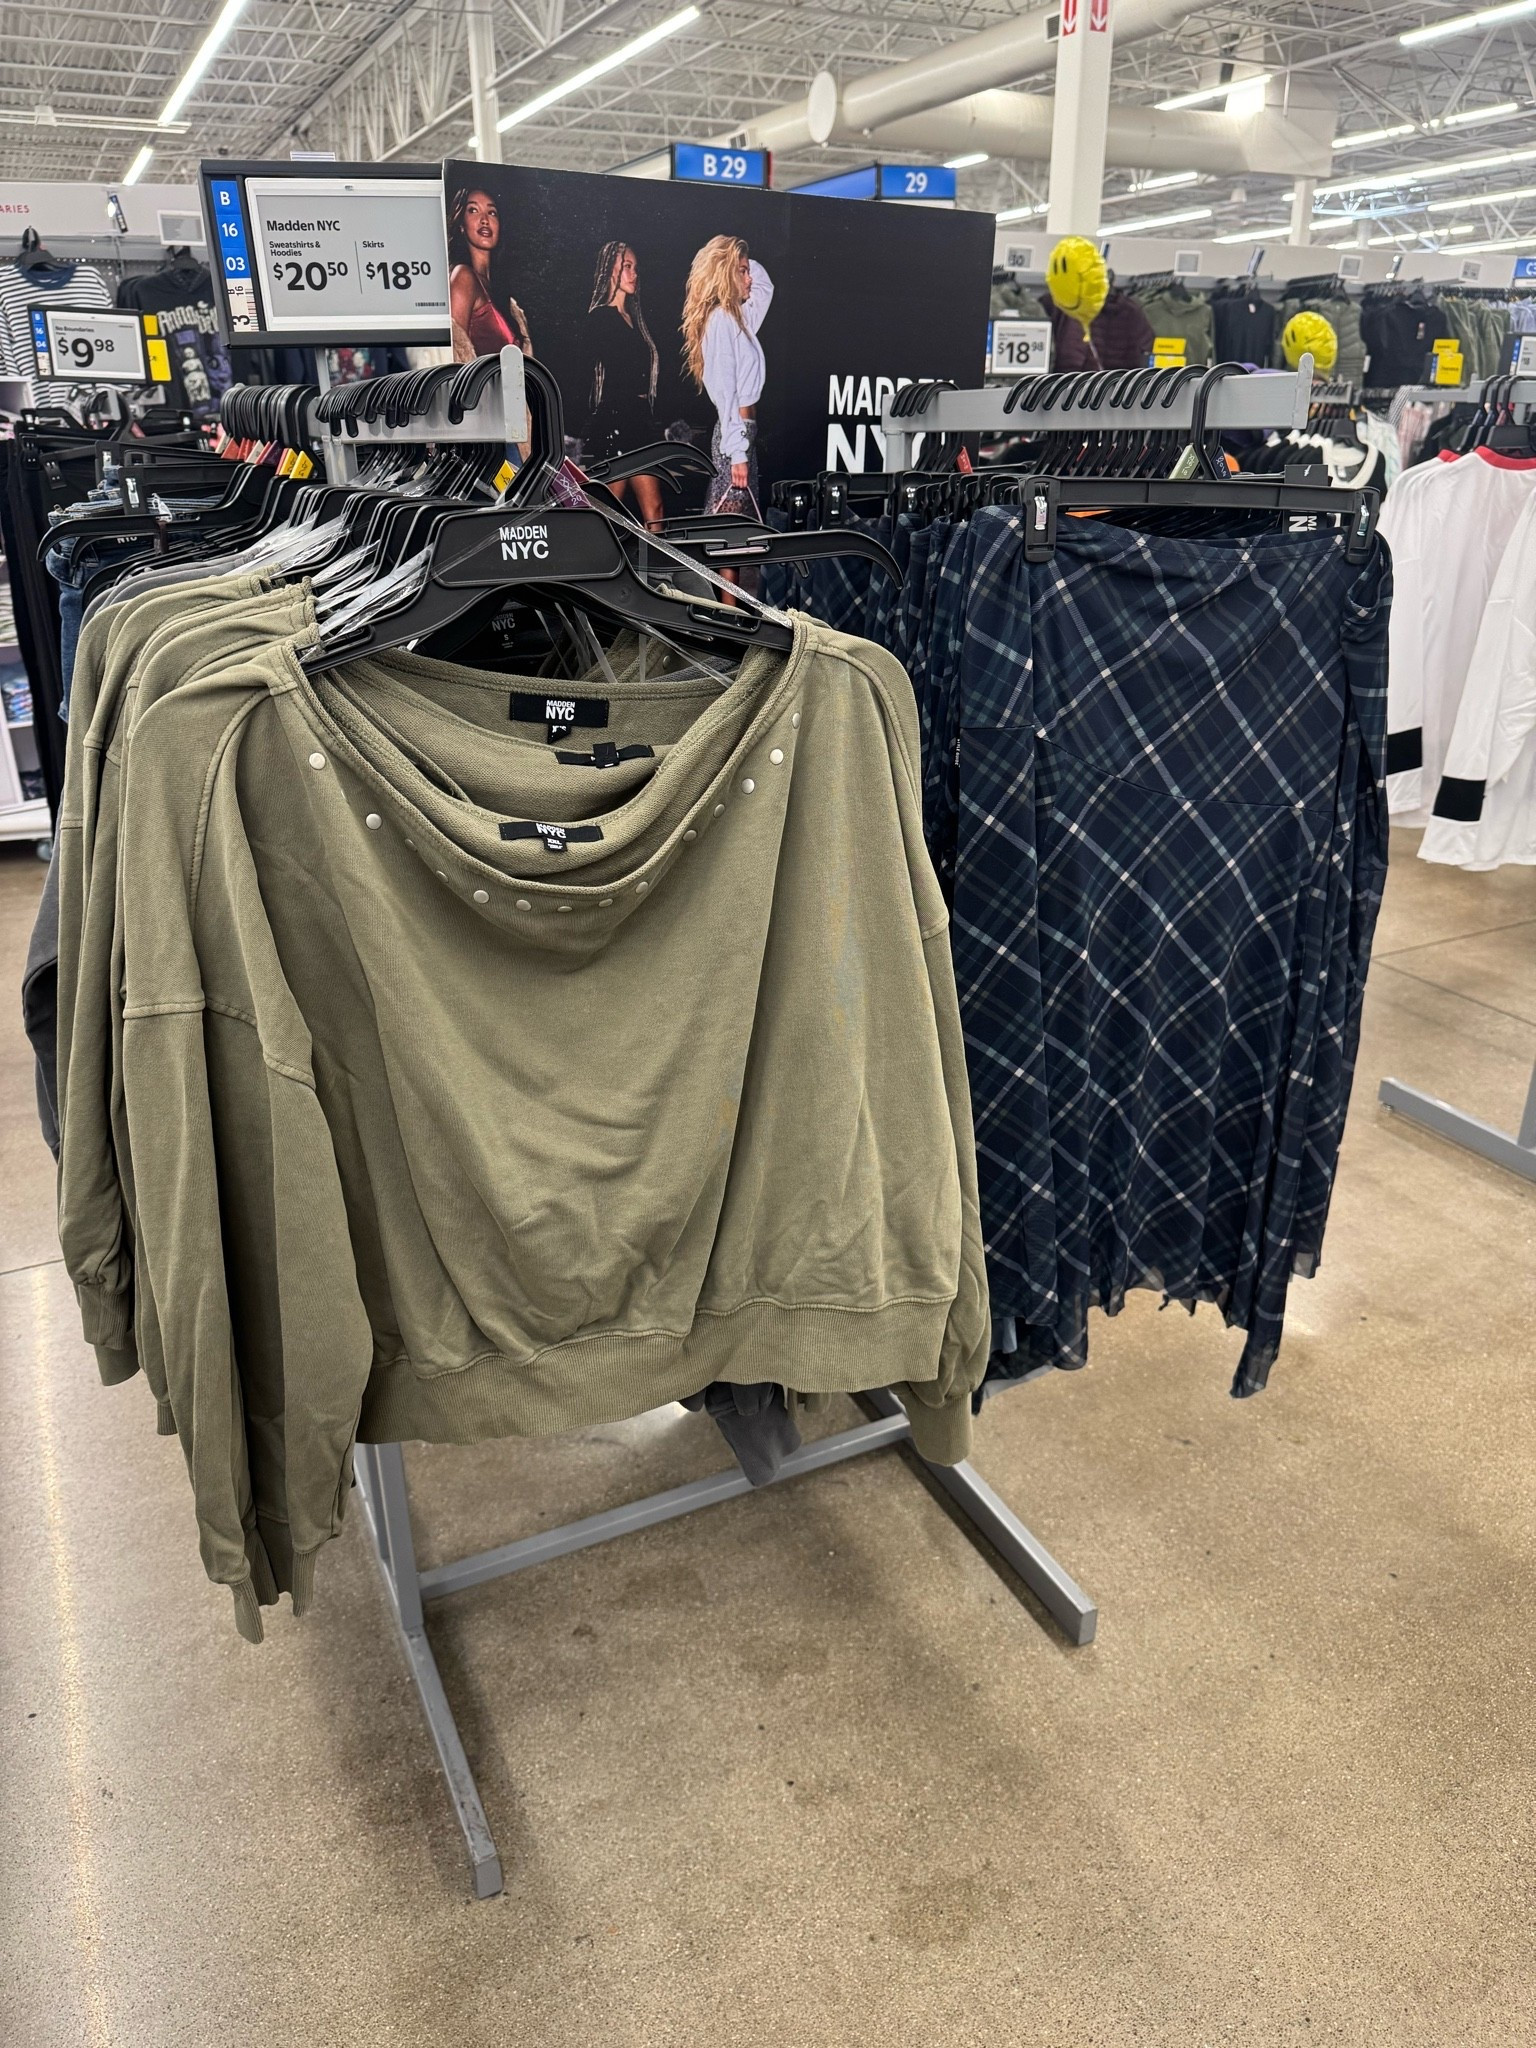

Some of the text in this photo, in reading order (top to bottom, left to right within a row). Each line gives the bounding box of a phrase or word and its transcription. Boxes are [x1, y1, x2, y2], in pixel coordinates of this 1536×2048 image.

[703, 154, 747, 179] B 29
[905, 172, 928, 193] 29
[219, 191, 231, 206] B
[222, 222, 238, 238] 16
[266, 220, 341, 231] Madden NYC
[269, 240, 321, 248] Sweatshirts &
[362, 240, 385, 248] Skirts
[270, 249, 302, 257] Hoodies
[226, 256, 246, 272] 03
[500, 525, 548, 540] MADDEN
[501, 540, 549, 560] NYC
[492, 618, 516, 632] NYC
[546, 699, 576, 708] MADDEN
[545, 706, 575, 721] NYC
